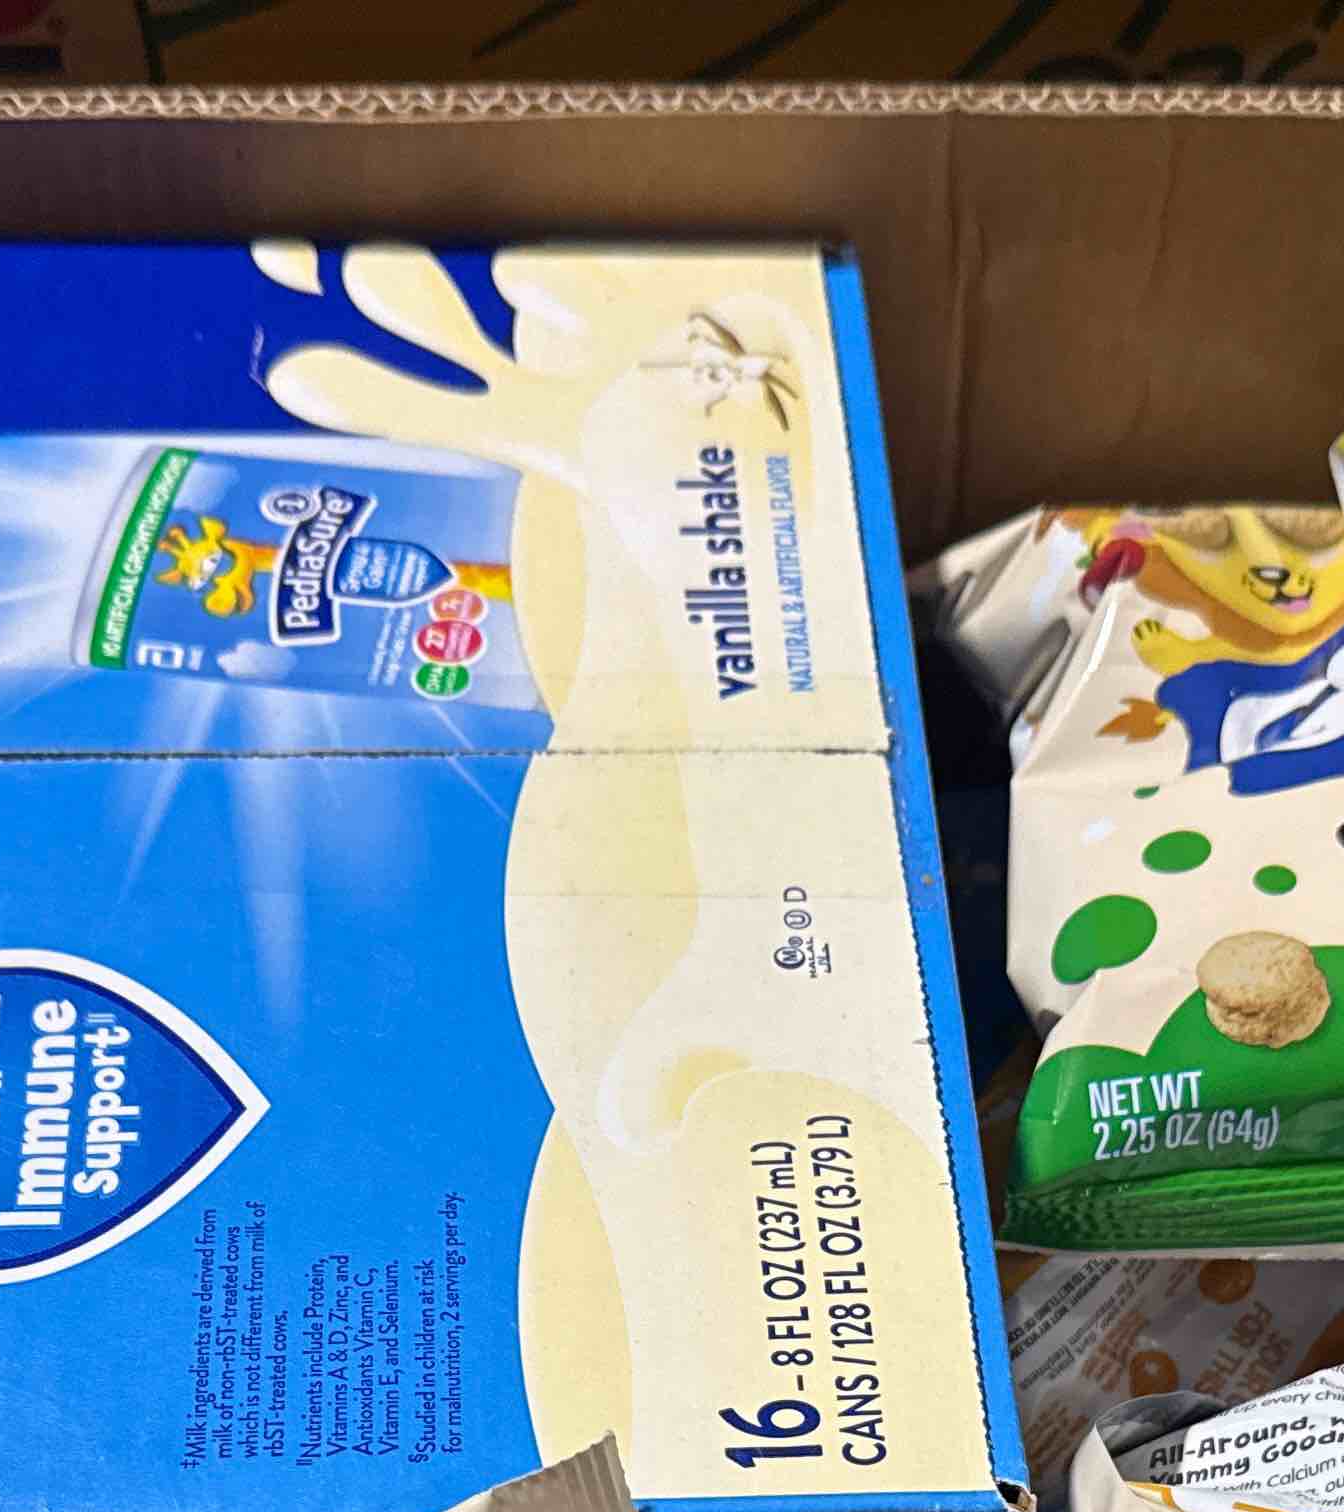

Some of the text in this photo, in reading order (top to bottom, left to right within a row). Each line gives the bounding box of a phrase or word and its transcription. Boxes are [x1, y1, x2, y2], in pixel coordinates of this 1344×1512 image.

[674, 445, 758, 700] vanilla shake
[767, 455, 815, 692] NATURAL & ARTIFICIAL FLAVOR
[1087, 1072, 1202, 1121] NET WT
[1092, 1106, 1279, 1161] 2.25 OZ (64g)
[327, 1255, 352, 1456] Vitamins A & D, Zinc, and
[352, 1268, 377, 1455] Antioxidants Vitamin C,
[719, 1141, 823, 1468] 16 8 FL OZ (237 mL)
[806, 1115, 887, 1466] CANS 128 FL OZ (3.79 L)
[1149, 1416, 1316, 1469] All-Around,
